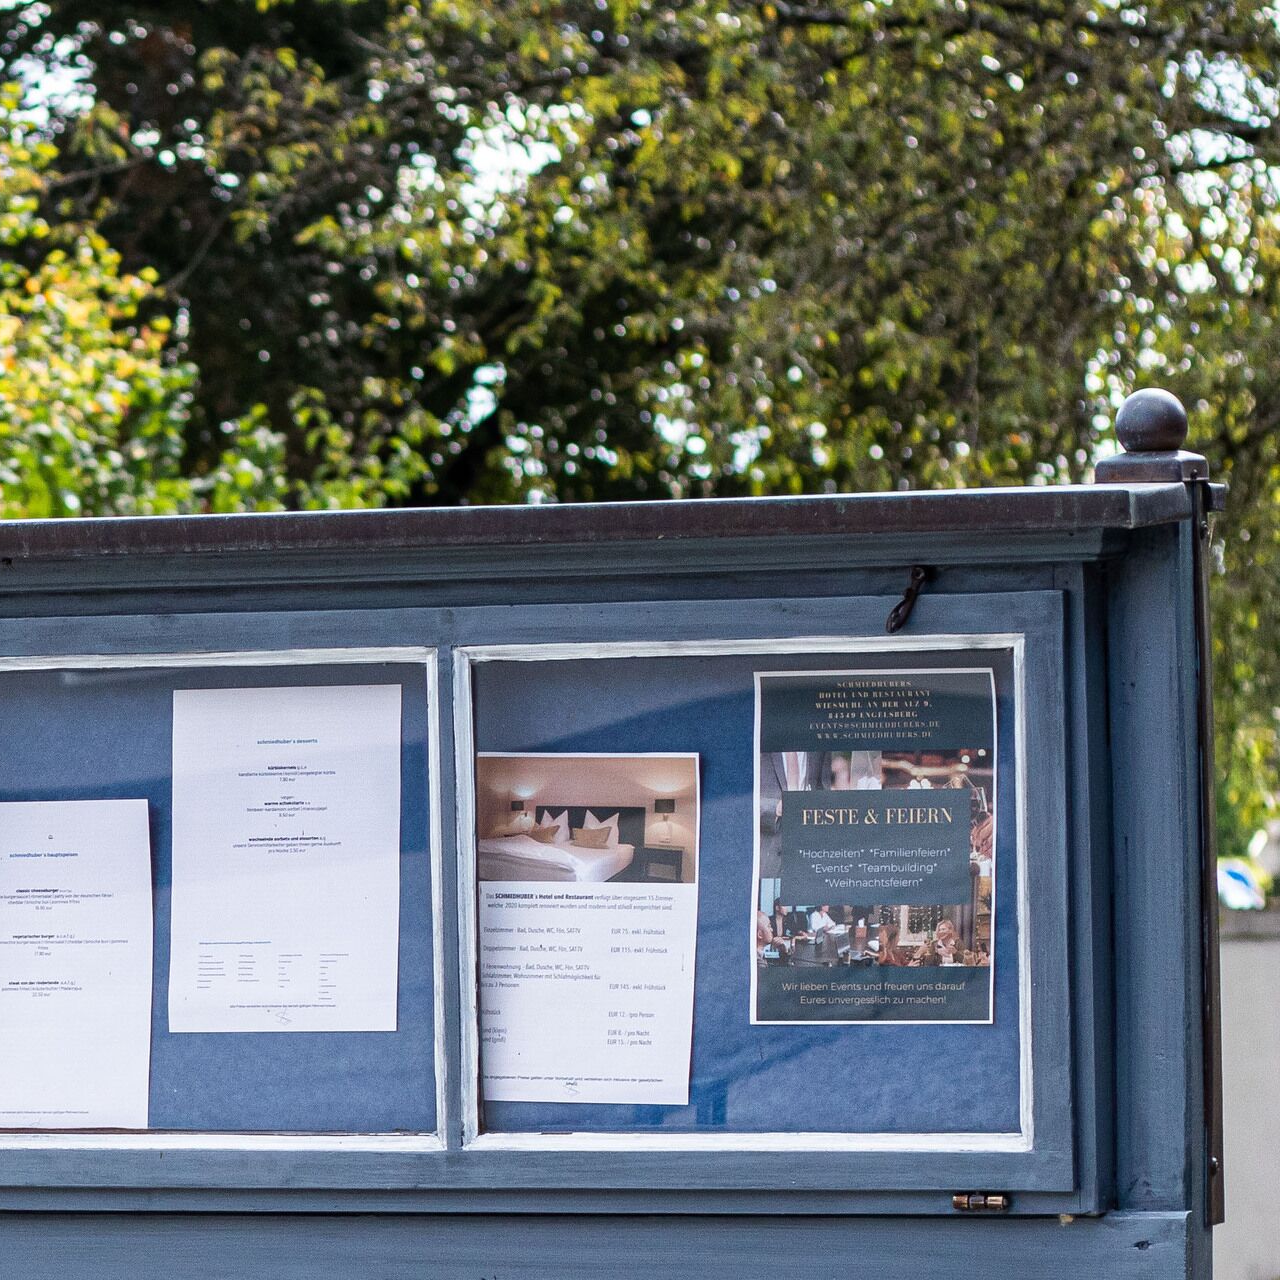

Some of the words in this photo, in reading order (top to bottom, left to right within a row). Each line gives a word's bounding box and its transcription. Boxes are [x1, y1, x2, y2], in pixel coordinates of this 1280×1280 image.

[818, 691, 848, 699] HOTEL
[852, 691, 869, 699] UND
[872, 690, 931, 699] RESTAURANT
[802, 808, 859, 826] FESTE
[864, 808, 880, 825] &
[885, 808, 953, 825] FEIERN
[782, 982, 799, 991] Wir
[800, 982, 828, 991] lieben
[831, 982, 862, 991] Events
[863, 982, 882, 991] und
[884, 982, 913, 991] freuen
[916, 982, 933, 991] uns
[934, 982, 966, 991] darauf
[800, 996, 826, 1005] Eures
[828, 996, 890, 1005] unvergesslich
[893, 996, 904, 1005] zu
[906, 996, 947, 1005] machen!
